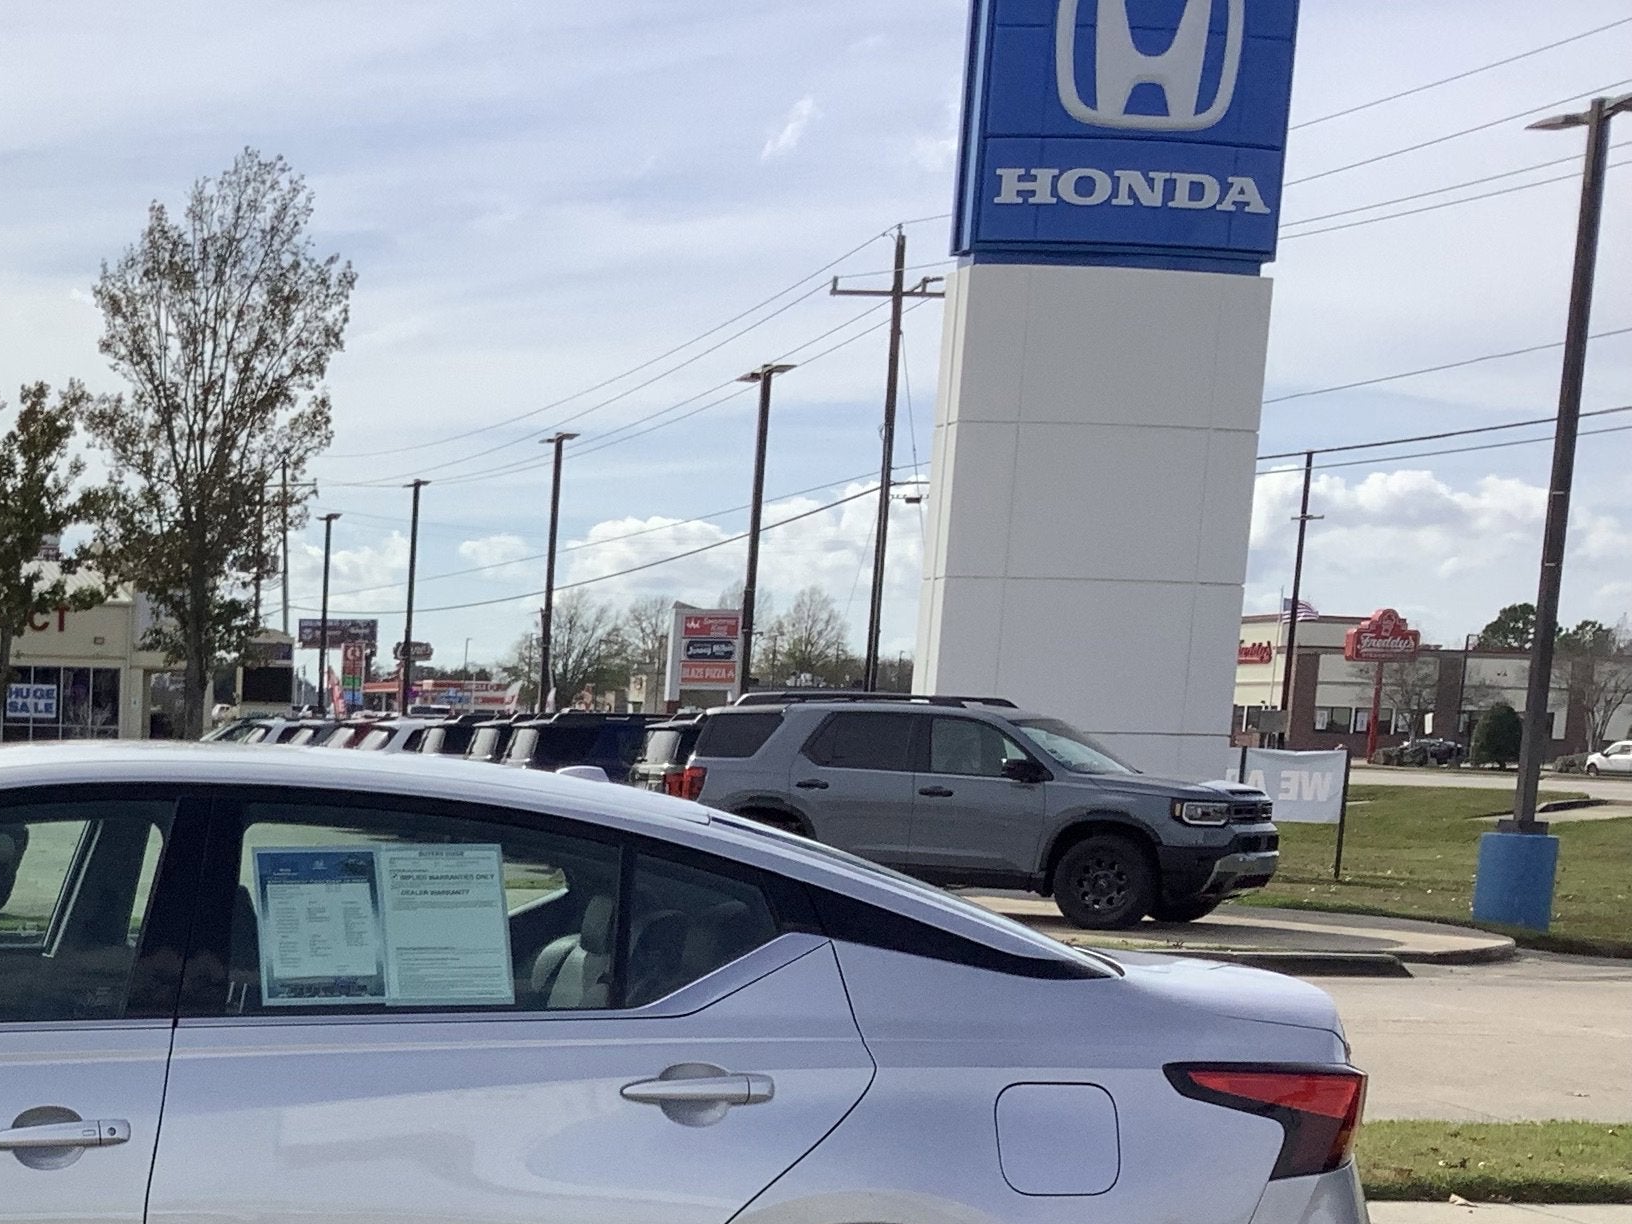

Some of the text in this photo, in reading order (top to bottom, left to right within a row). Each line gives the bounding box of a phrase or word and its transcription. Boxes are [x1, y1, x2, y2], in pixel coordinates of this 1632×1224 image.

[994, 168, 1271, 214] HONDA
[1357, 632, 1415, 650] Freddy's
[705, 667, 726, 678] PIZZA
[7, 685, 57, 700] HUGE
[7, 701, 55, 715] SALE
